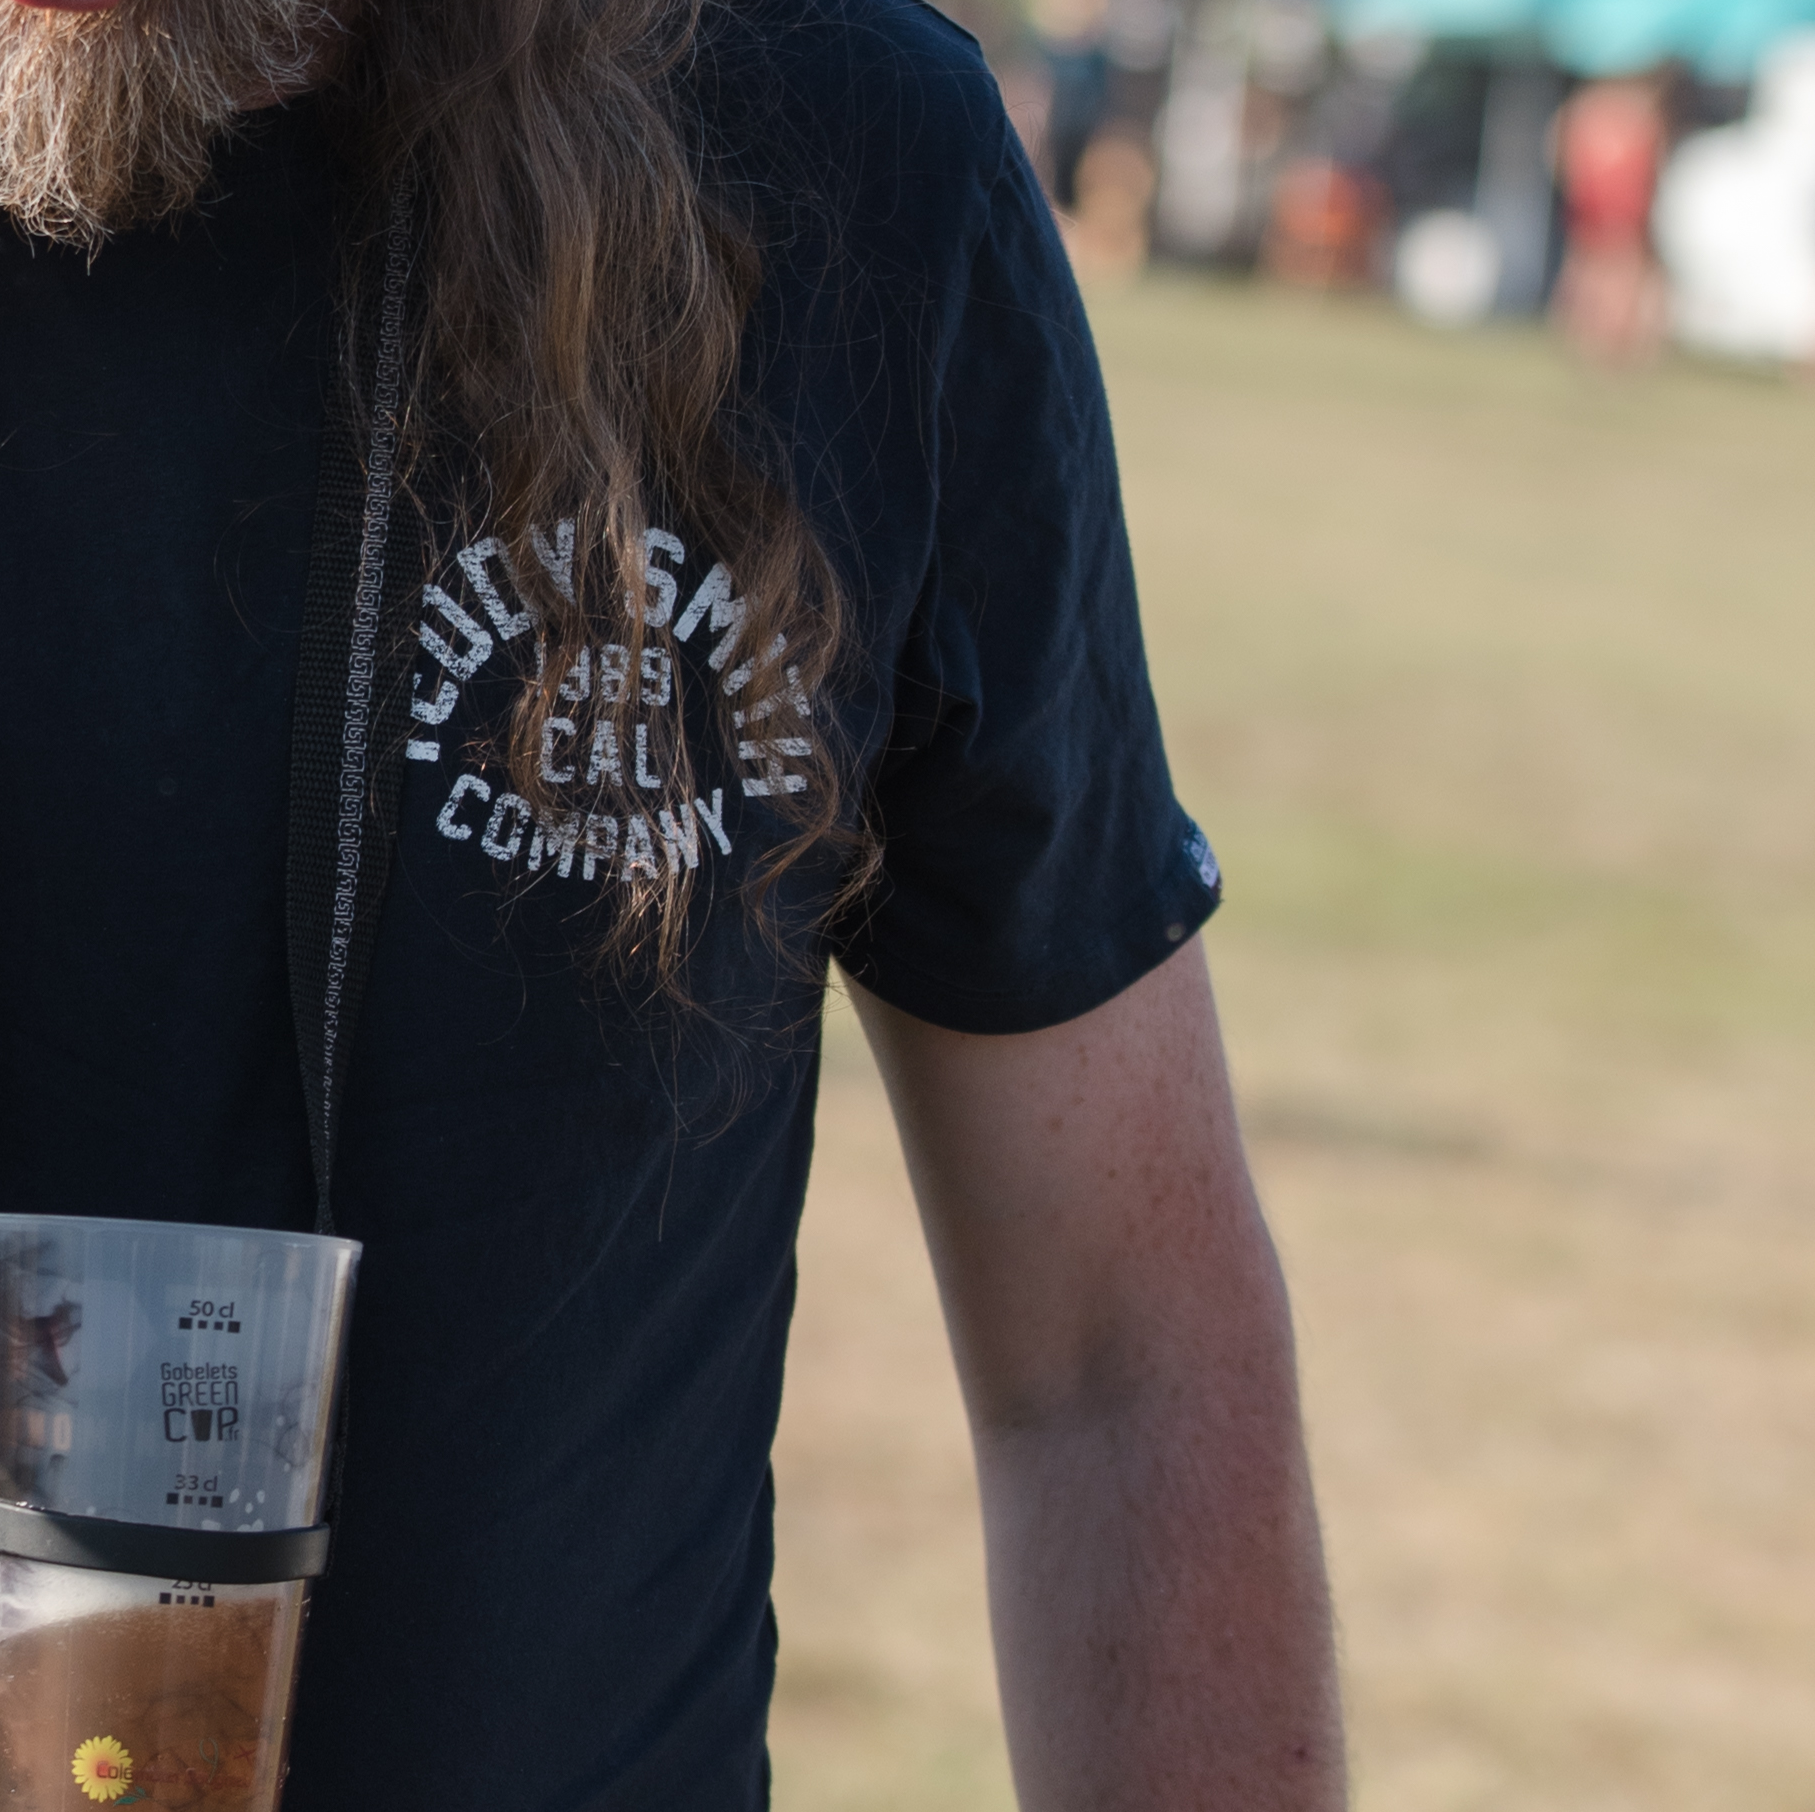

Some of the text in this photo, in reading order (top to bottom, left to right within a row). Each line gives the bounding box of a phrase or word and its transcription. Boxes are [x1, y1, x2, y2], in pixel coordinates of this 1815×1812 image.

[540, 716, 661, 789] CAL
[436, 773, 733, 882] COMPANY
[189, 1299, 214, 1317] 50
[161, 1362, 238, 1381] Gobelets
[161, 1380, 239, 1407] GREEN
[175, 1473, 199, 1491] 33
